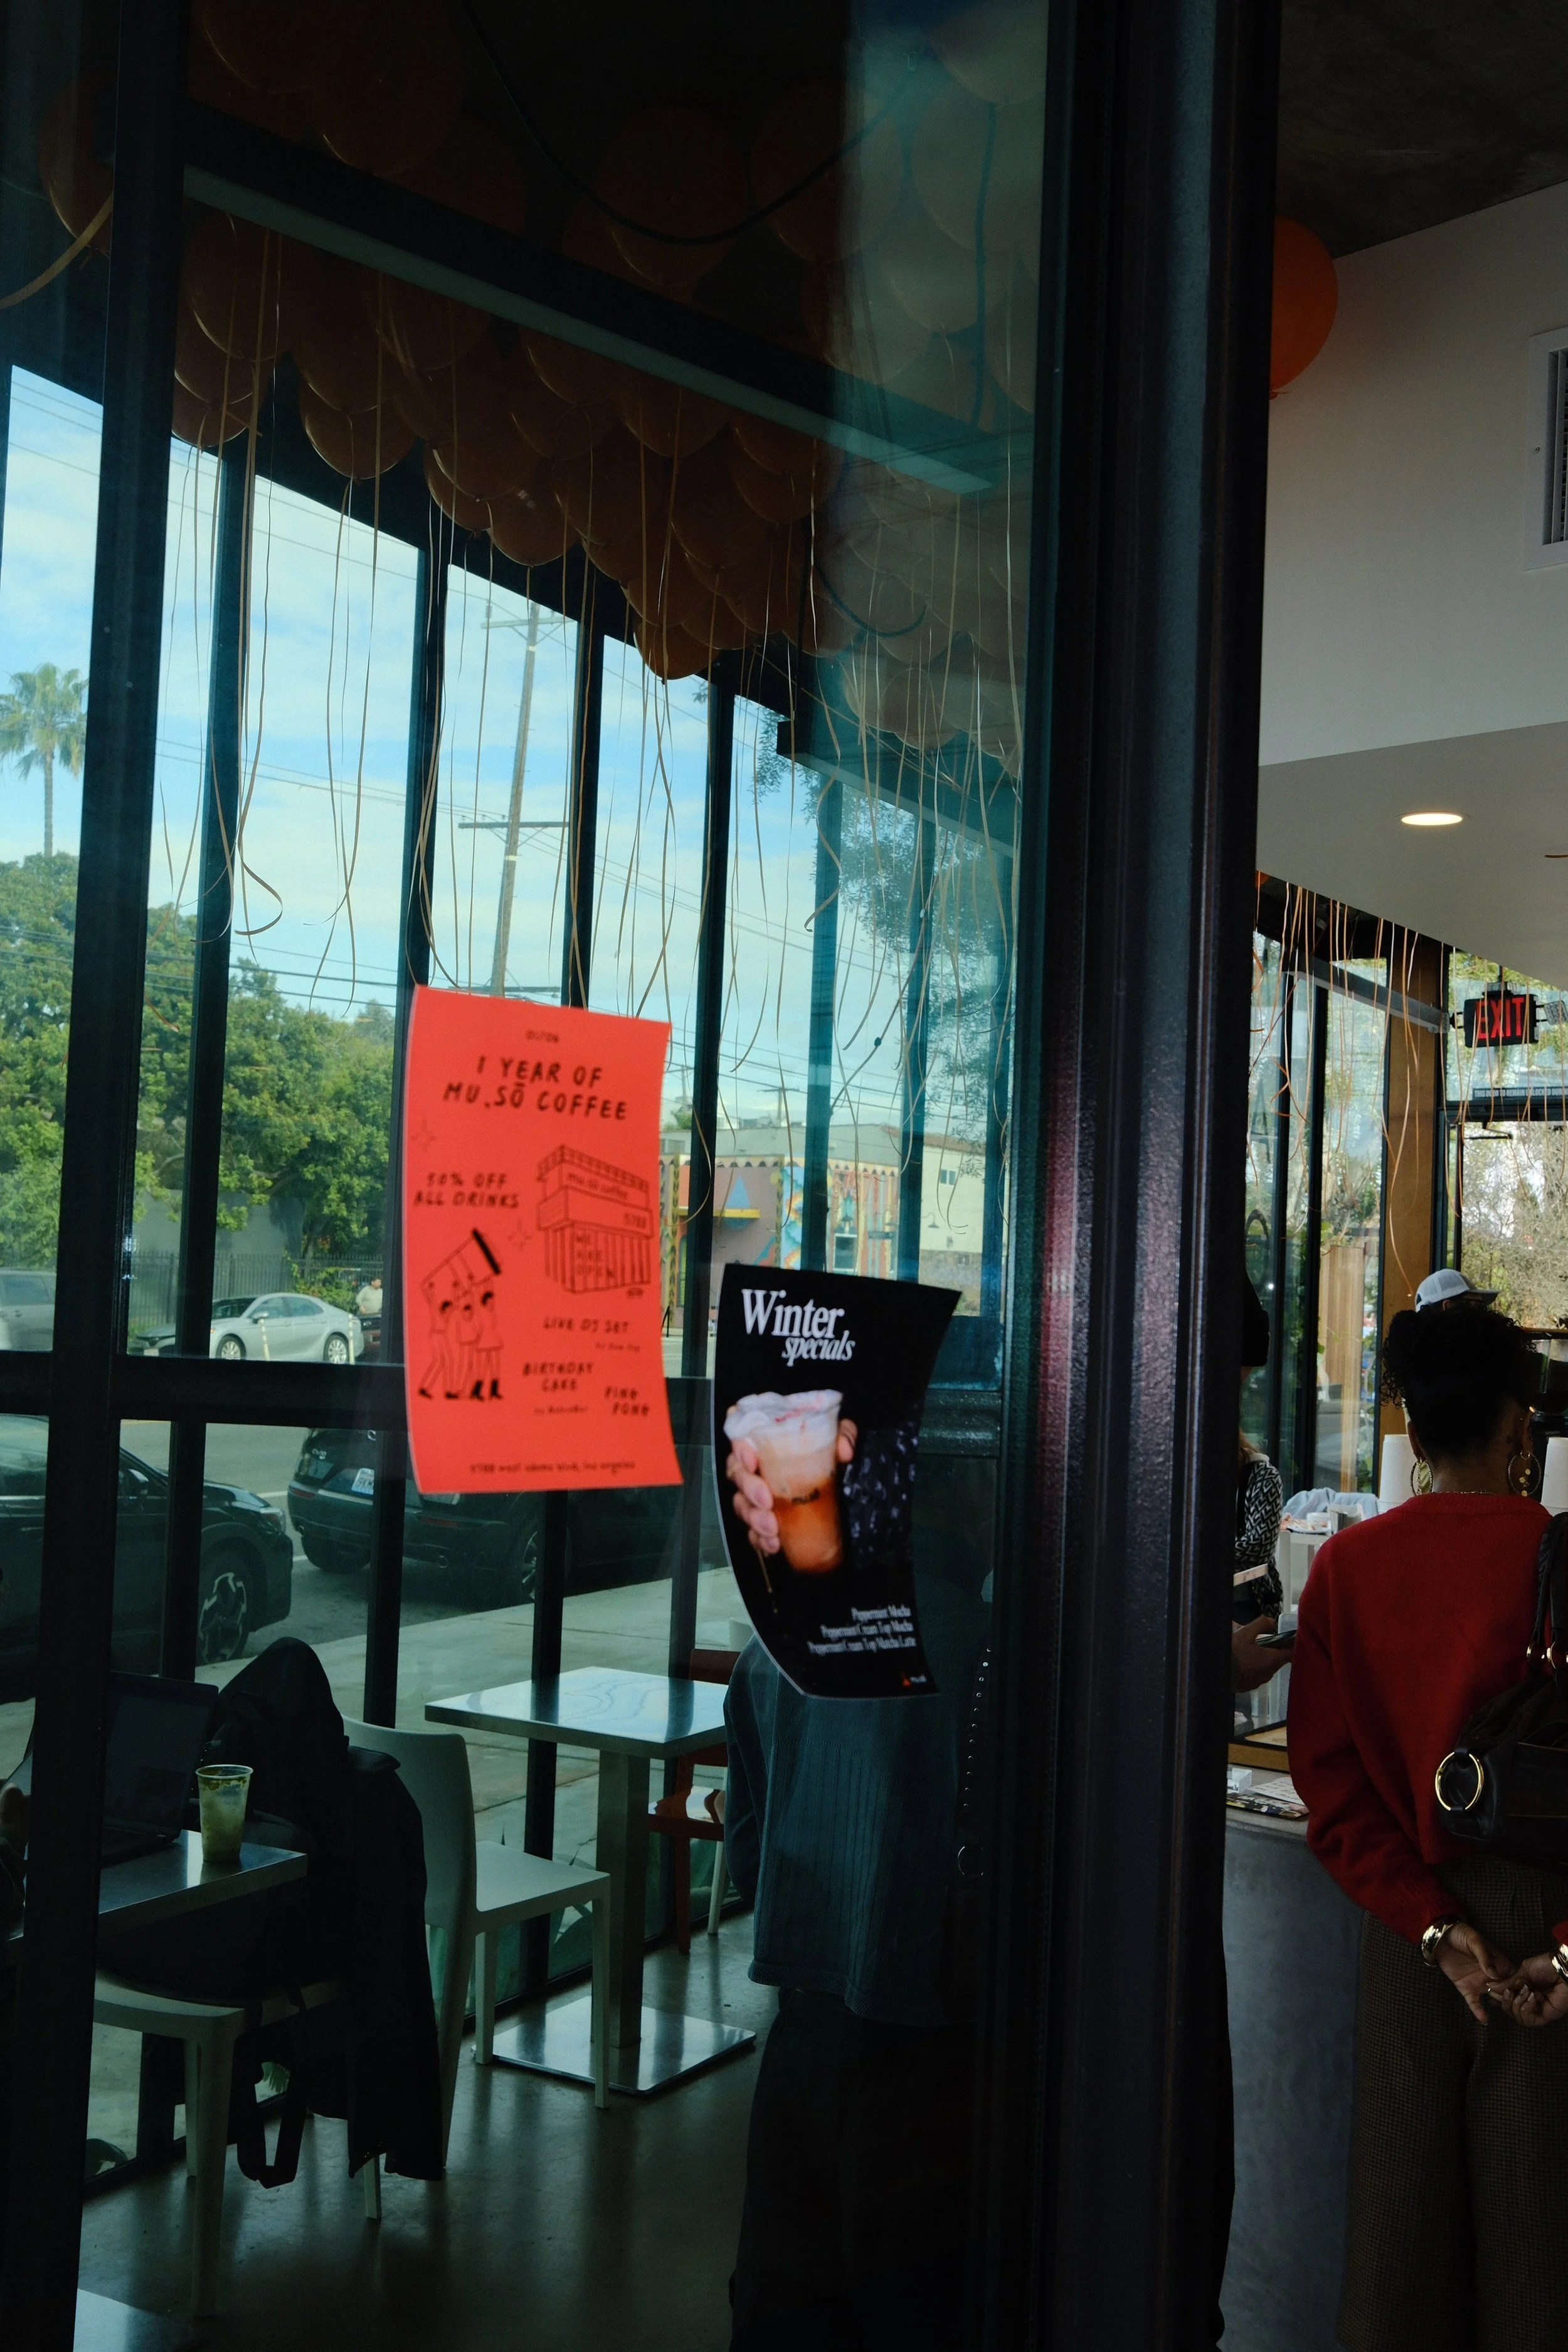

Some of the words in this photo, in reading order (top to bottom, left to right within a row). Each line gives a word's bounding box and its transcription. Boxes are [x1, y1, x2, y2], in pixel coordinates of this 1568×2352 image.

[1475, 997, 1525, 1039] EXIT
[477, 1056, 486, 1074] 1
[501, 1057, 560, 1083] YEAR
[573, 1067, 603, 1088] OF
[537, 1091, 627, 1120] COFFEE
[474, 1172, 507, 1189] OFF
[413, 1190, 444, 1207] ALL
[452, 1190, 519, 1209] DRINKS
[741, 1289, 845, 1338] Winter
[580, 1318, 599, 1333] DJ
[605, 1320, 628, 1334] SET
[781, 1330, 855, 1367] specials
[522, 1362, 593, 1376] BIRTHDAY
[542, 1379, 576, 1392] CAKE
[605, 1385, 638, 1400] PING
[612, 1402, 649, 1416] PONG
